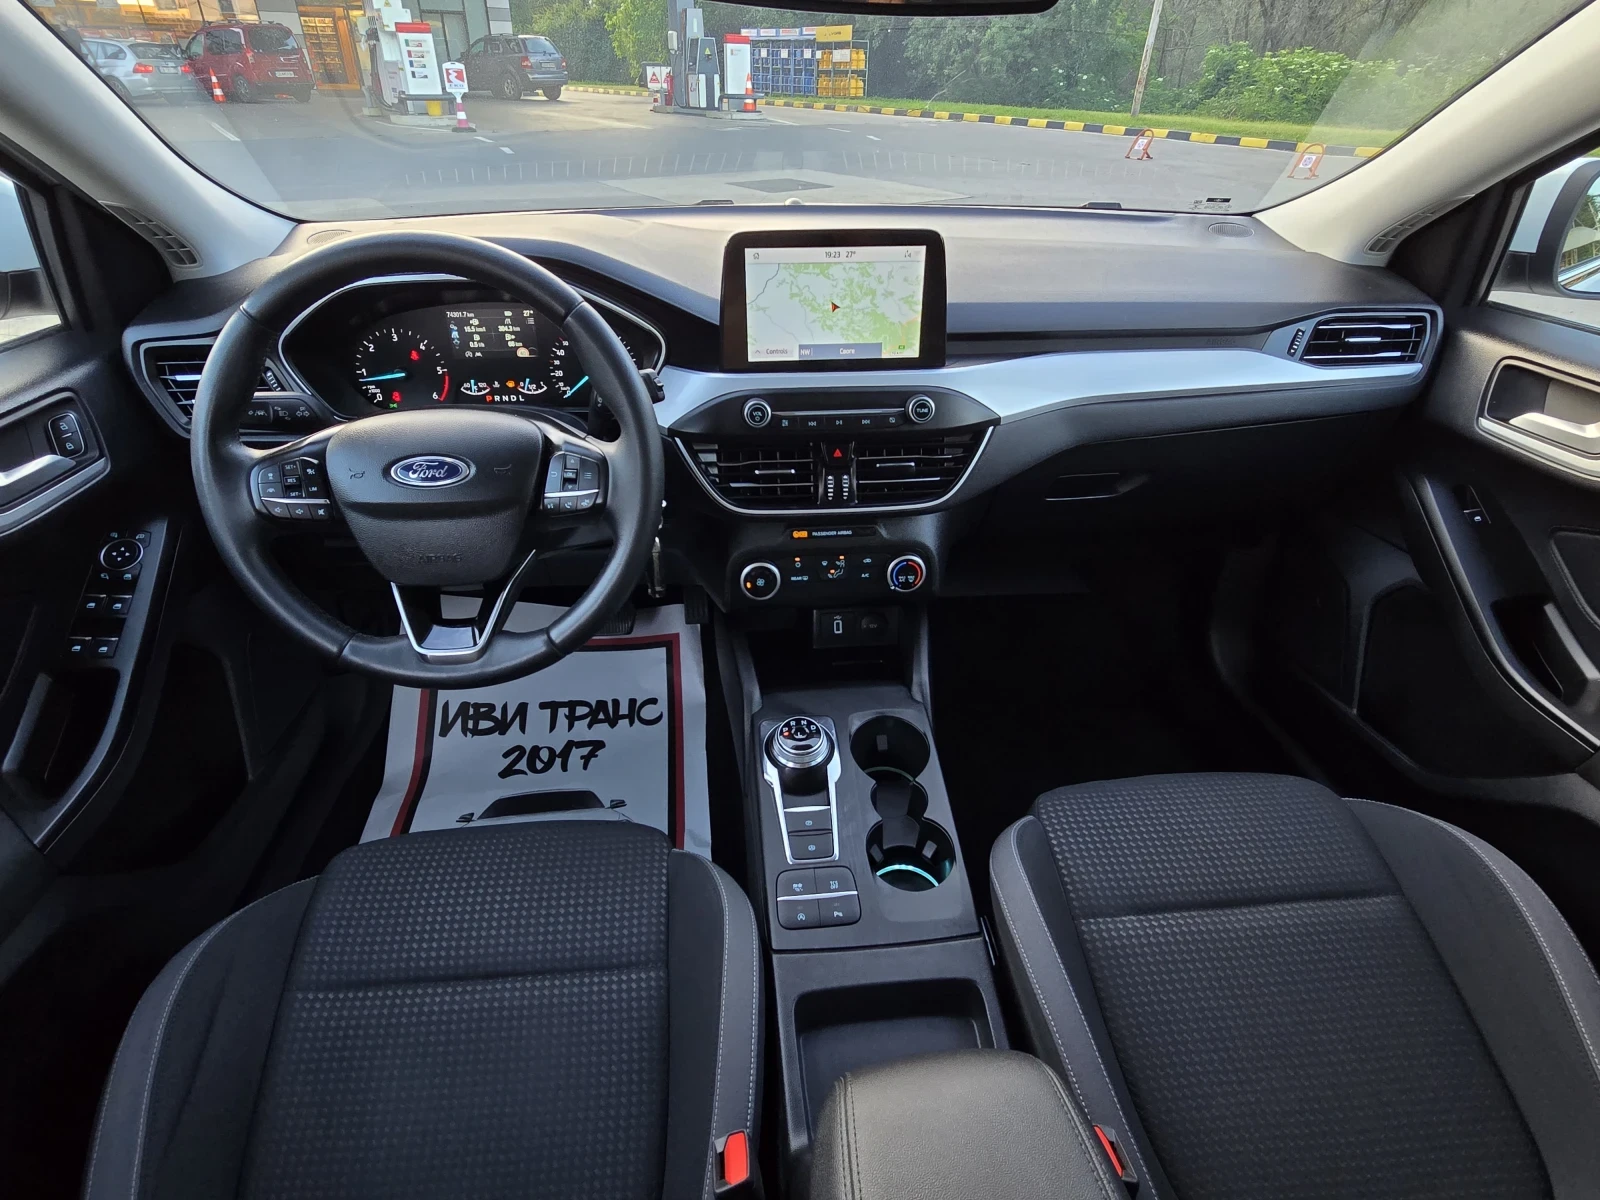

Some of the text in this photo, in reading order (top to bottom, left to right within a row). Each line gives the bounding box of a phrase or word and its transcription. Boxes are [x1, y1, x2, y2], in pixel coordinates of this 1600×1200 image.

[824, 251, 841, 259] 19:23
[391, 333, 398, 342] 3
[368, 343, 375, 352] 2
[419, 342, 426, 351] 4
[361, 368, 367, 376] 1
[436, 366, 443, 375] 5
[376, 393, 383, 401] 0
[432, 391, 439, 400] 6
[408, 461, 449, 479] Ford
[438, 697, 664, 738] ИВИ ТРАНС
[497, 739, 607, 780] 2017
